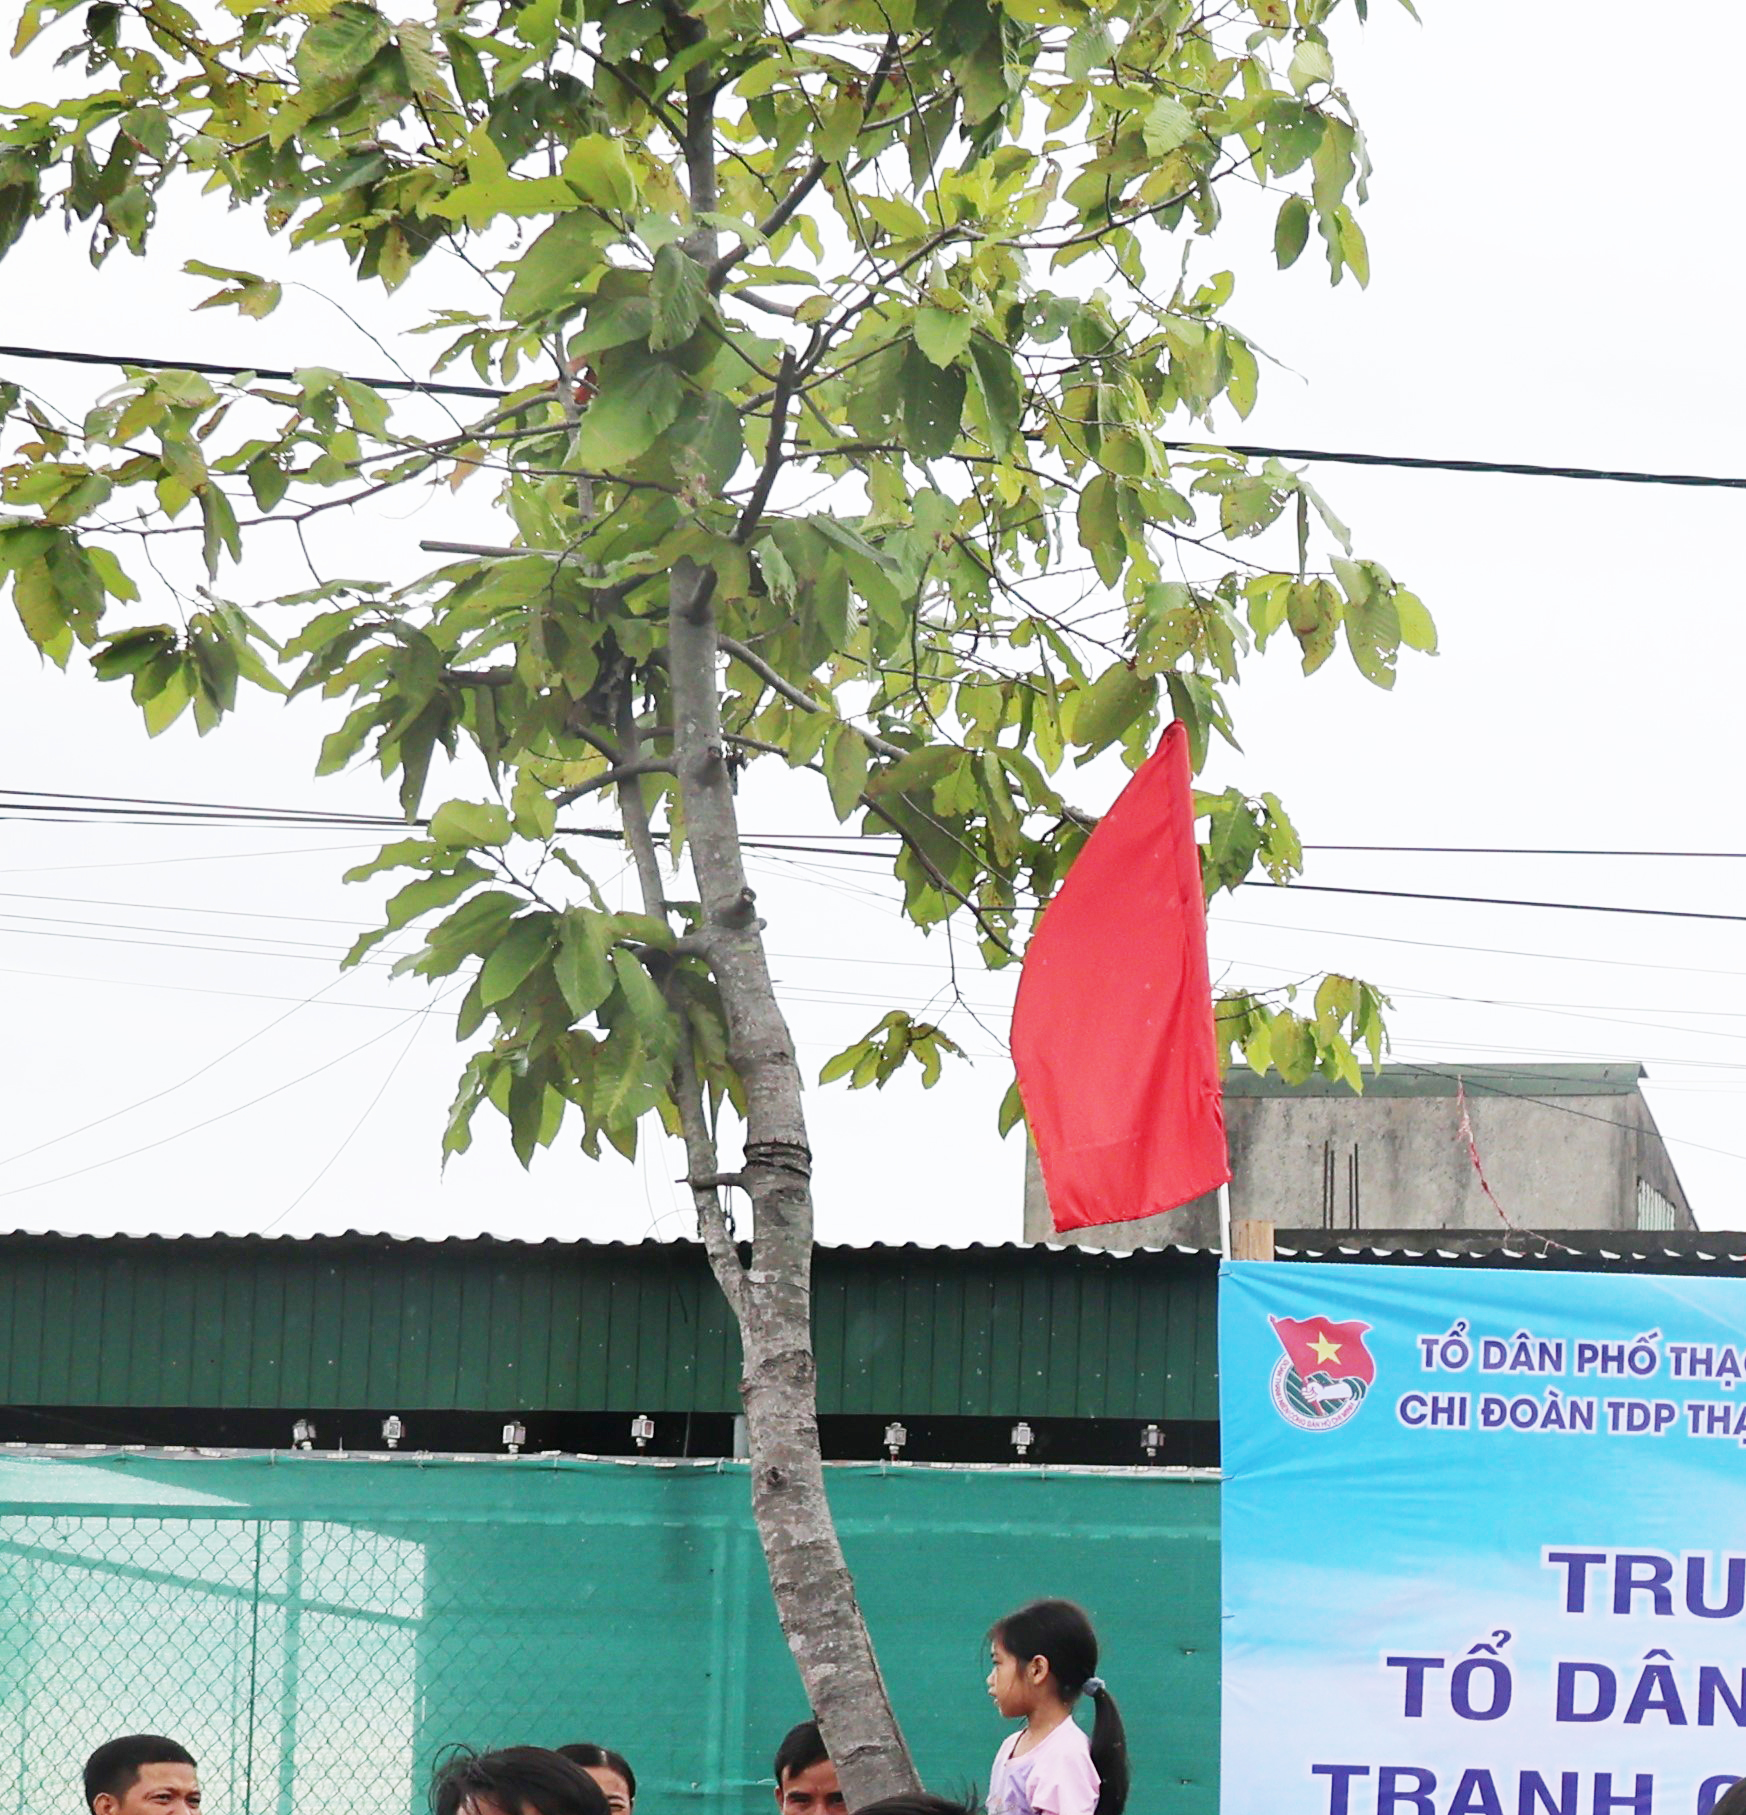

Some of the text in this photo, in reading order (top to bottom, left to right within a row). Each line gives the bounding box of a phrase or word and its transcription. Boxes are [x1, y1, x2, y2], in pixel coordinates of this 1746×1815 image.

[1422, 1320, 1469, 1369] TỔ
[1483, 1333, 1563, 1372] DÂN
[1578, 1329, 1662, 1375] PHỐ
[1399, 1394, 1468, 1427] CHI
[1481, 1389, 1595, 1430] ĐOÀN
[1608, 1401, 1677, 1432] TDP
[1387, 1630, 1511, 1720] TỔ
